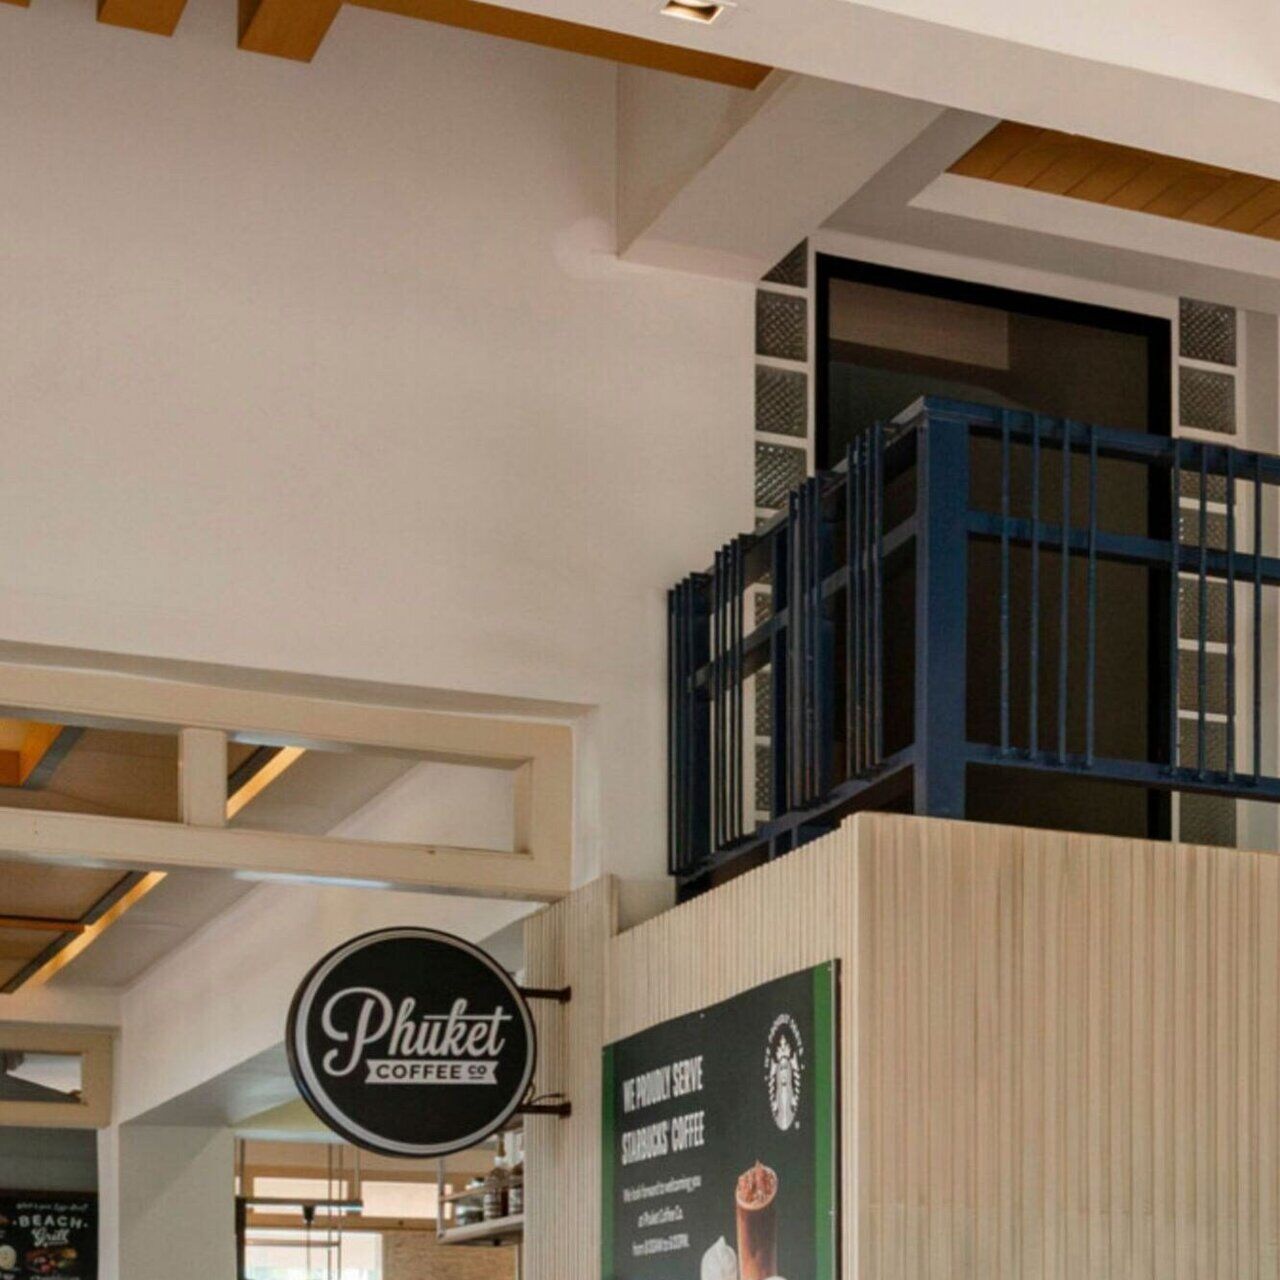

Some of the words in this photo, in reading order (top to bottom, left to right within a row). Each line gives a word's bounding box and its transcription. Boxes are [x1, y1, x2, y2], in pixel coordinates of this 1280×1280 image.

[321, 986, 513, 1077] Phuket
[376, 1064, 462, 1080] COFFEE
[468, 1064, 488, 1077] CO
[623, 1078, 636, 1114] WE
[672, 1055, 703, 1098] SERVE
[671, 1110, 705, 1153] COFFEE
[19, 1214, 82, 1229] BEACH
